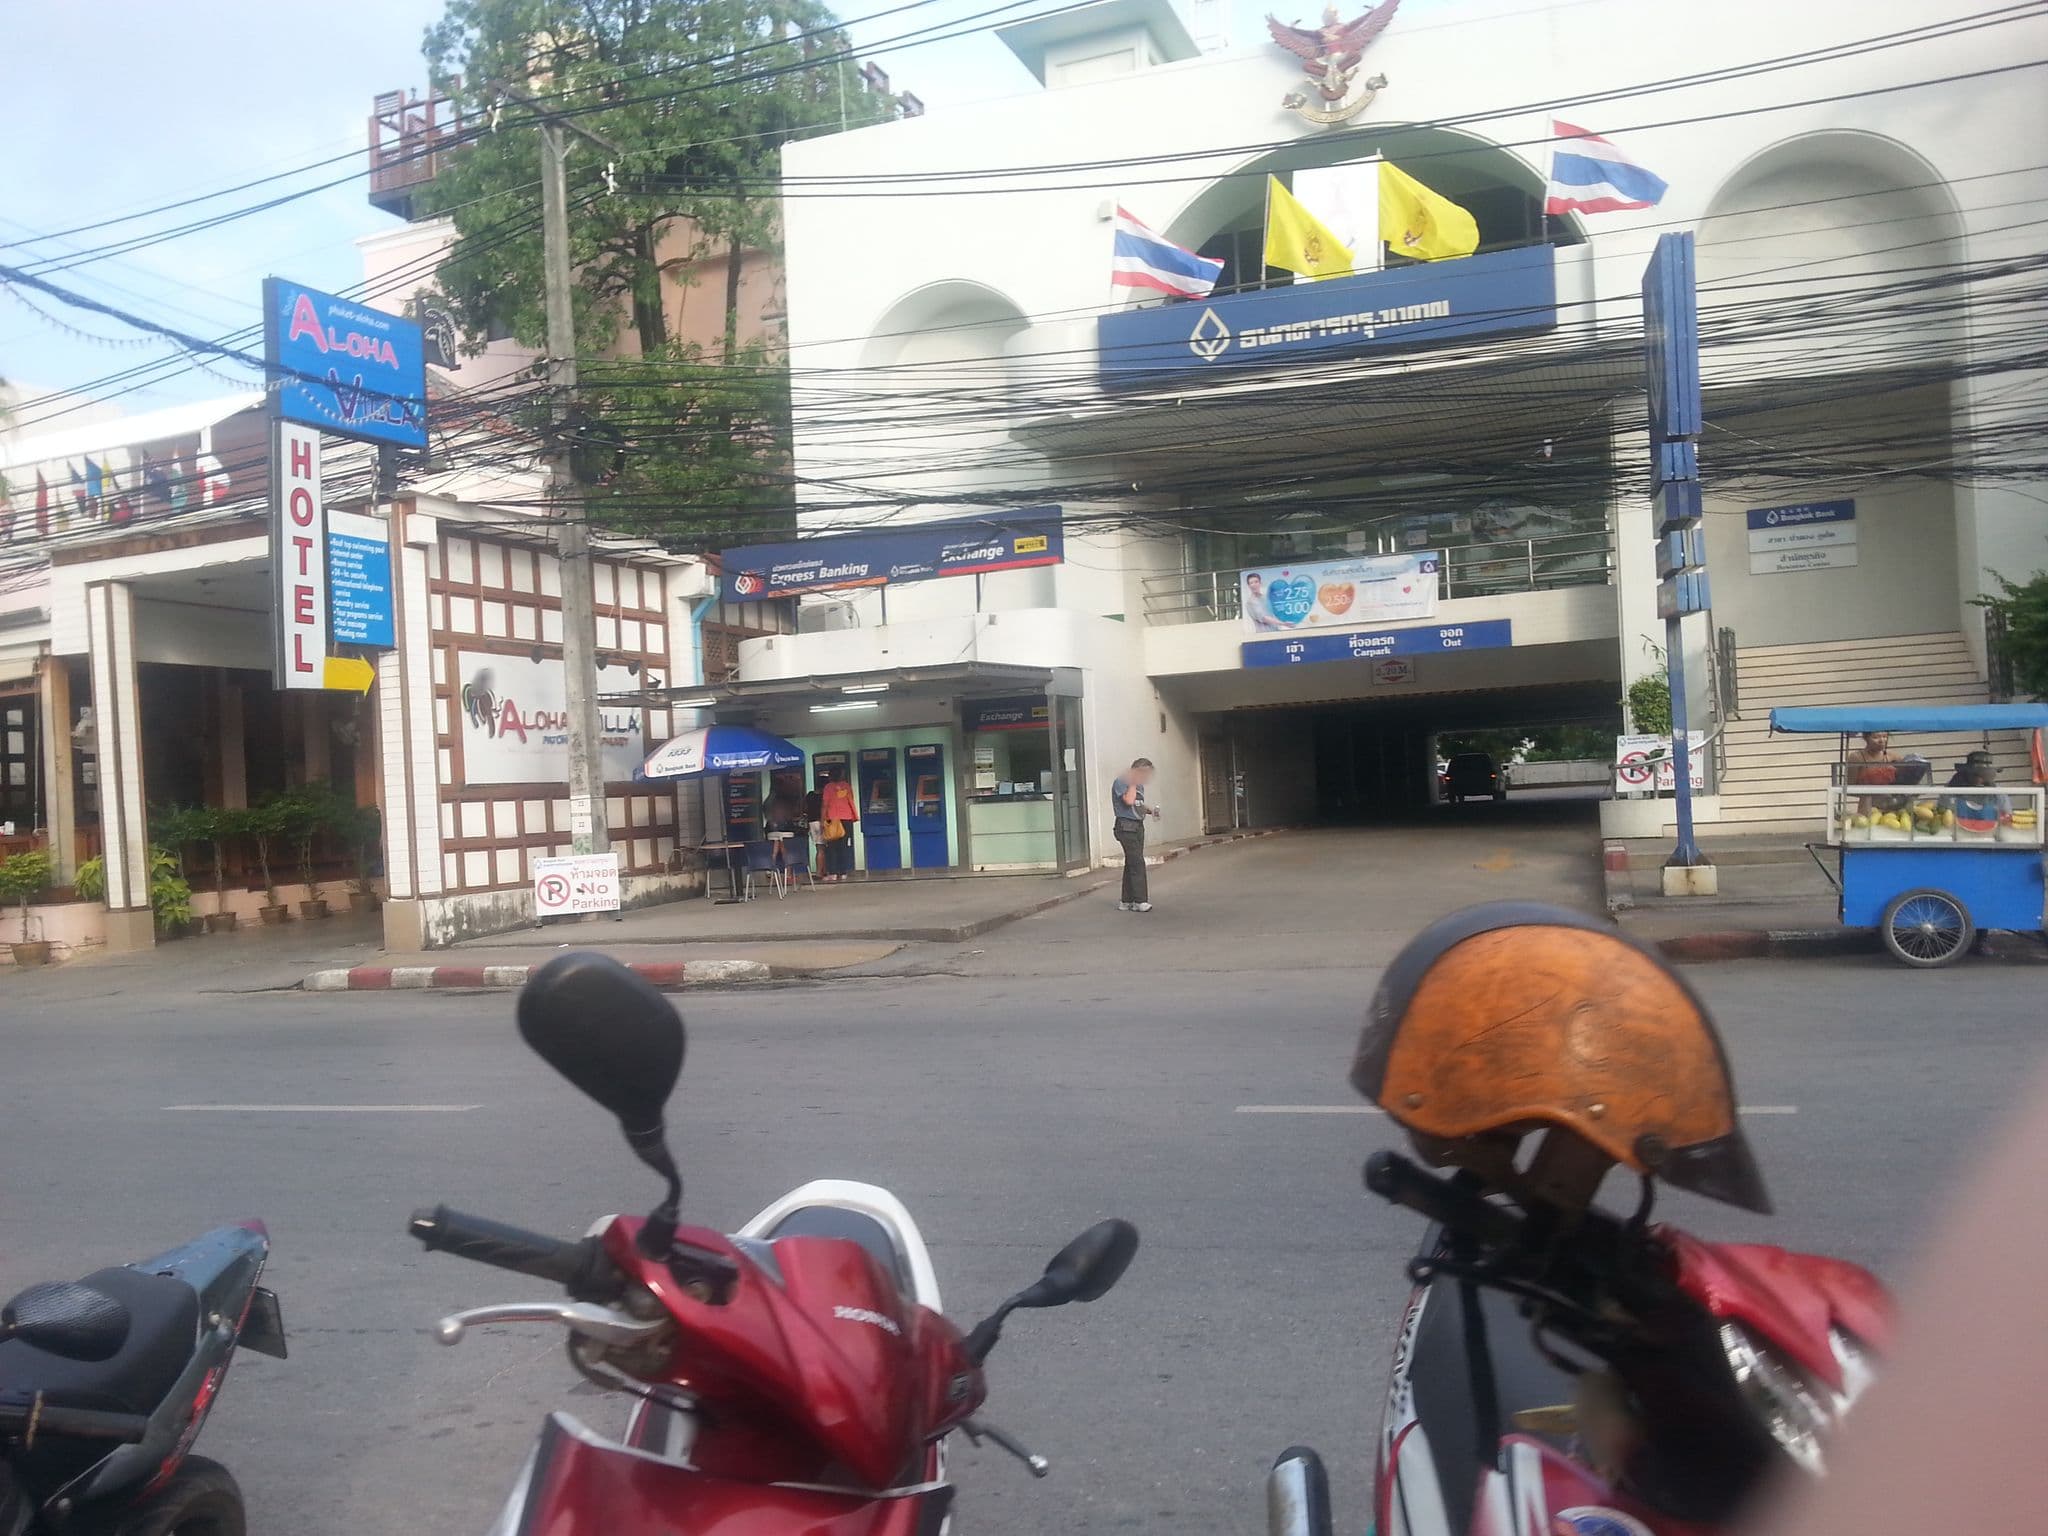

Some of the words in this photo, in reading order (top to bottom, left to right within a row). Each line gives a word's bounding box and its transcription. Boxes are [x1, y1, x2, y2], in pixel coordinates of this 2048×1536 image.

[1240, 300, 1449, 338] ธนาคารกรุงเทพ
[289, 293, 400, 370] ALOHA
[290, 438, 316, 673] HOTEL
[770, 570, 815, 586] Express
[819, 563, 869, 580] Banking
[1284, 586, 1309, 600] 2.75
[1285, 601, 1310, 615] 3.00
[1440, 627, 1463, 638] ออก
[1286, 640, 1304, 653] เข้า
[1443, 638, 1462, 648] Out
[1290, 654, 1301, 663] In
[1353, 646, 1391, 659] Carpark
[979, 710, 1024, 723] Exchange
[570, 866, 617, 880] ห้ามจอด
[581, 882, 609, 895] No
[572, 898, 619, 909] Parking
